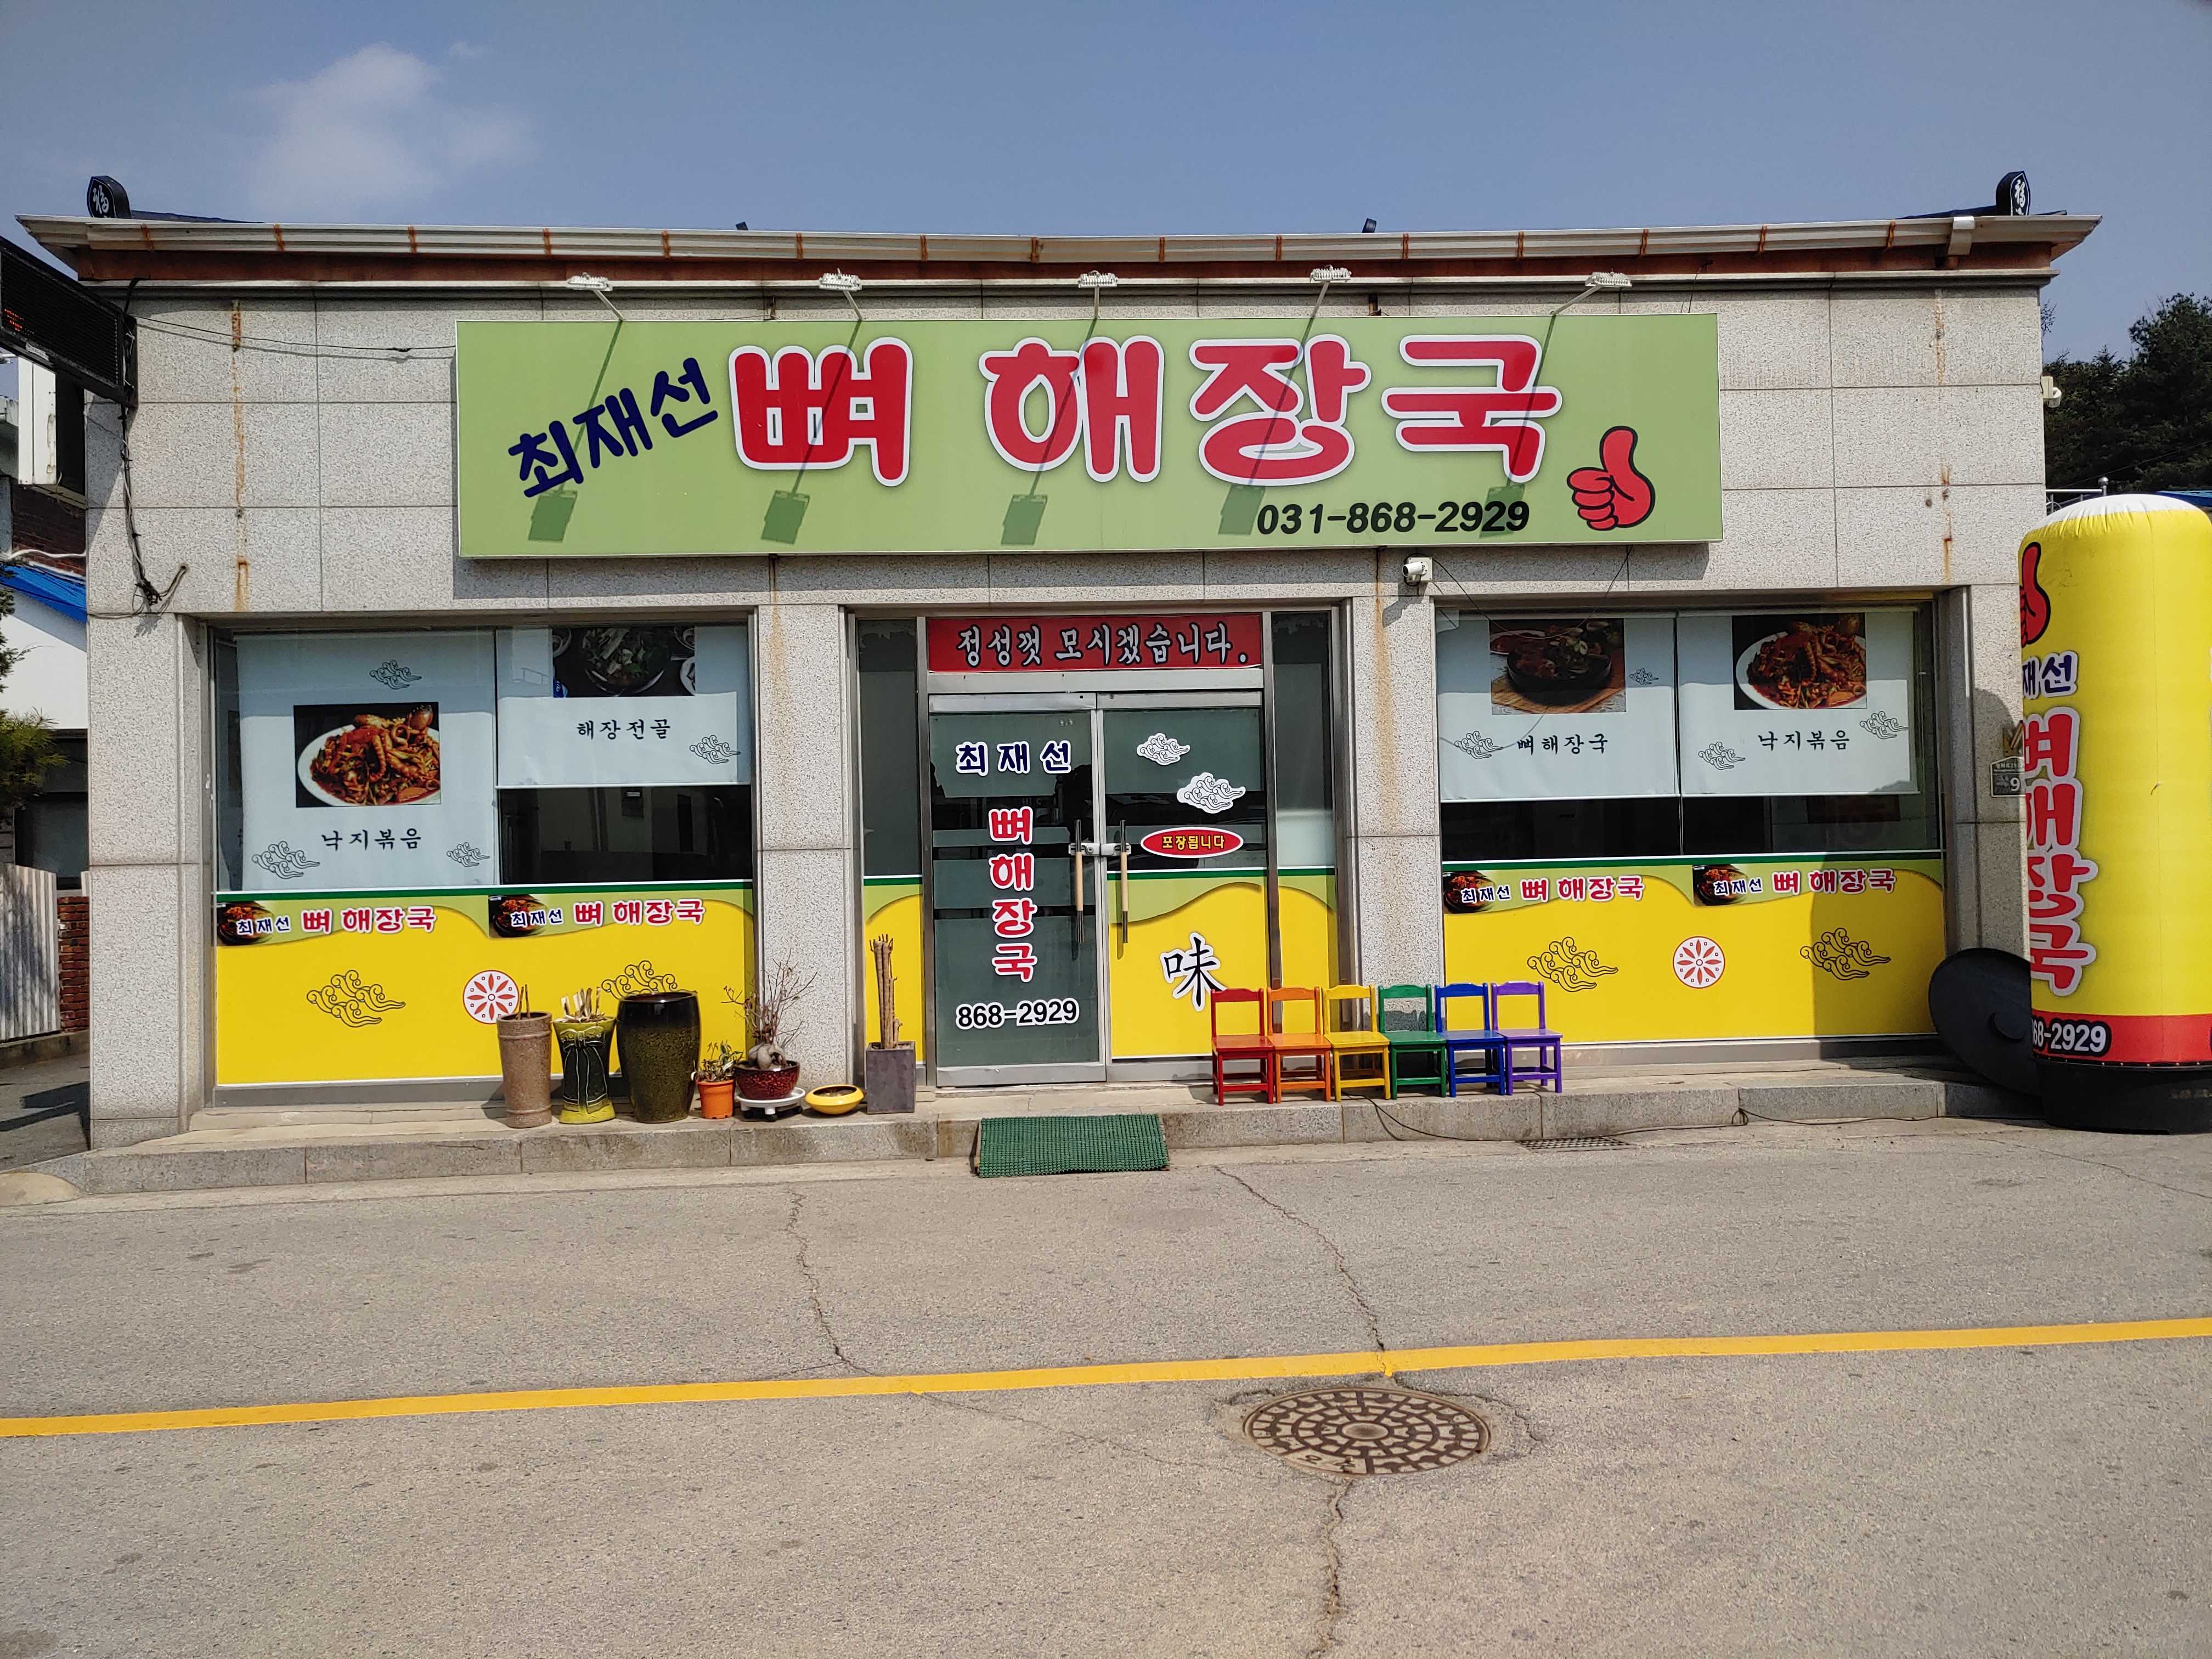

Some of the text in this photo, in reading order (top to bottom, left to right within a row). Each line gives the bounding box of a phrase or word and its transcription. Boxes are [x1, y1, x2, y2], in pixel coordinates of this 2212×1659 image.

[507, 335, 1563, 498] 최재선 뼈 해장국
[1257, 500, 1530, 535] 031-868-2929
[957, 622, 1246, 667] 정성껏 모시겠습니다.
[577, 718, 671, 740] 해장전골
[1516, 733, 1608, 755] 뼈해장국
[1757, 729, 1850, 752] 낙지볶음
[955, 740, 1071, 776] 최재선
[321, 828, 421, 851] 낙지볶음
[1162, 834, 1225, 850] 포장됩니다
[988, 806, 1037, 983] 뼈해장국
[1462, 874, 1645, 904] 최재선 뼈 해장국
[1713, 867, 1897, 896] 최재선 뼈 해장국
[237, 906, 437, 935] 최재선 뼈 해장국
[511, 898, 706, 928] 최재선 뼈 해장국
[1160, 932, 1227, 1012] 味
[955, 997, 1080, 1030] 868-2929
[2032, 1019, 2107, 1053] 68-2929
